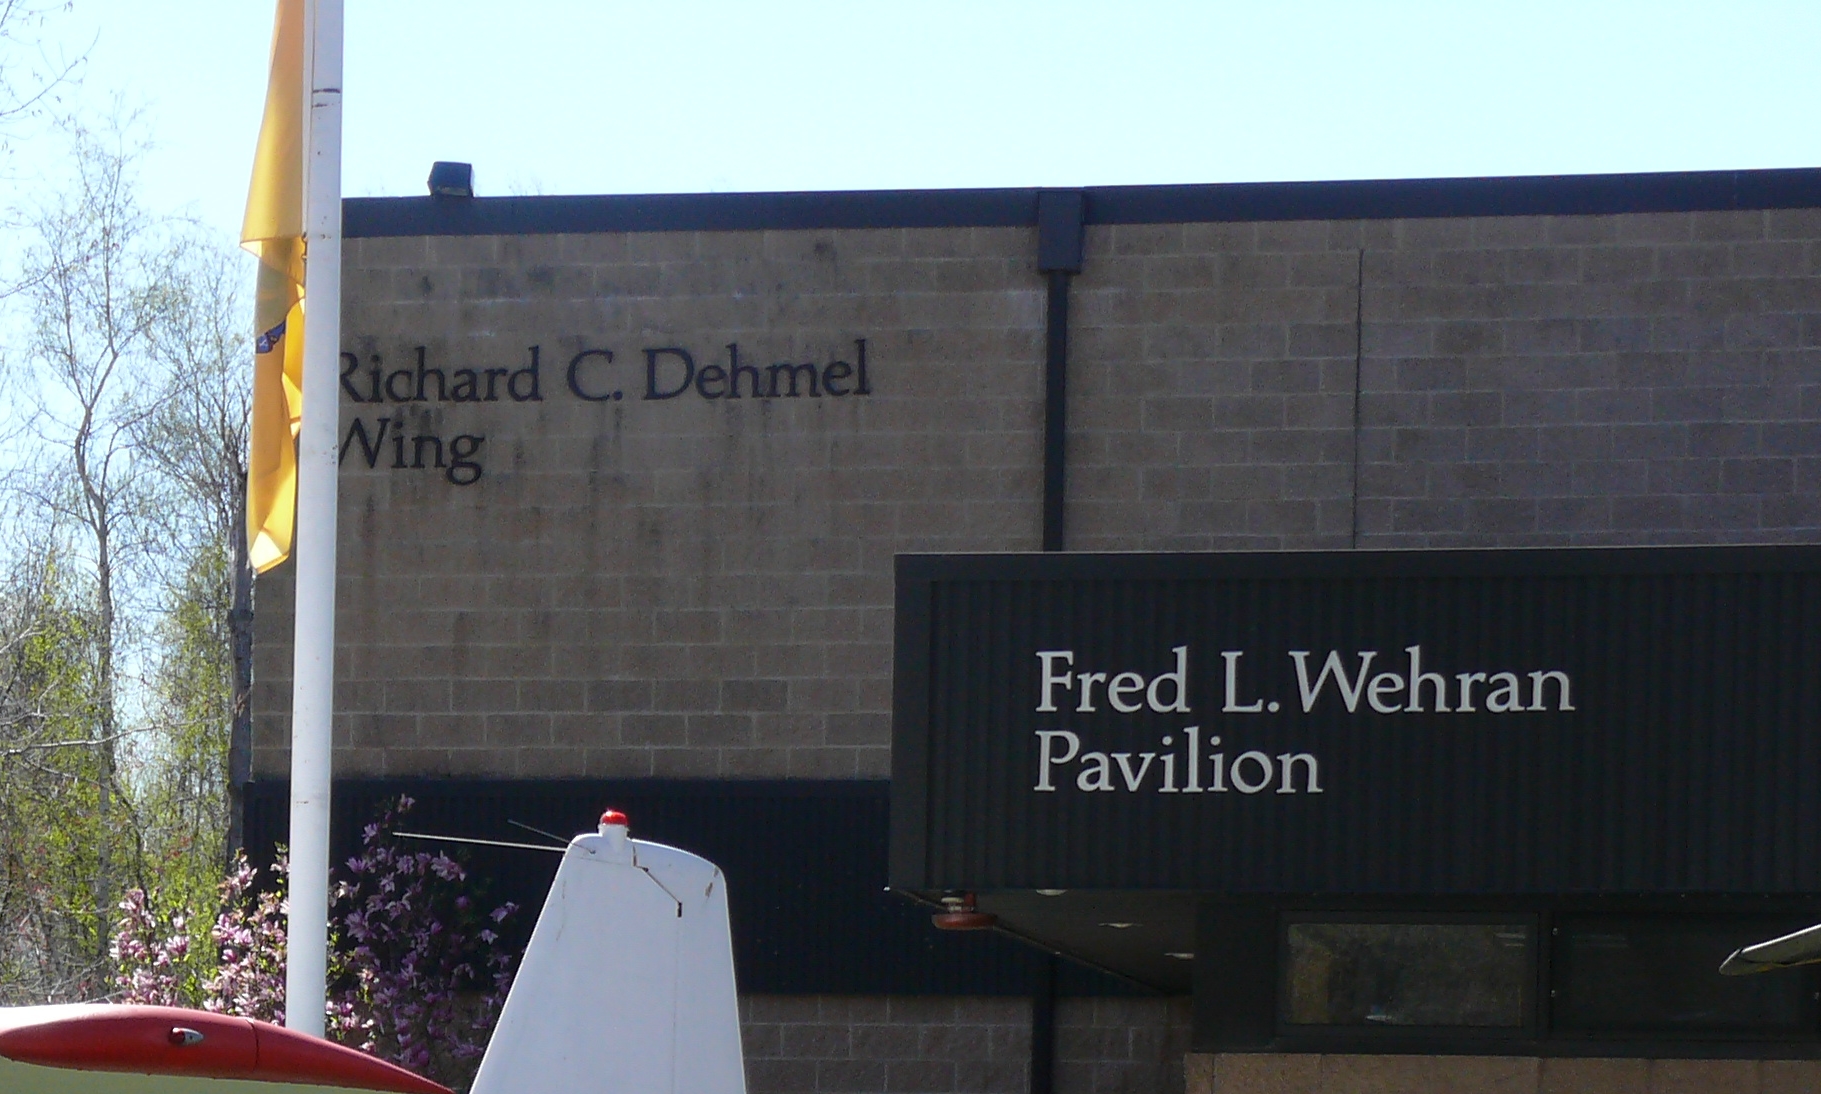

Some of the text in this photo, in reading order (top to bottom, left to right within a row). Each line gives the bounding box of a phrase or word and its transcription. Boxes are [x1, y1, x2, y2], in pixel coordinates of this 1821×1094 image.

[340, 339, 871, 402] Richard C. Dehmel
[338, 417, 485, 486] Wing
[1035, 646, 1190, 713] Fred
[1290, 646, 1575, 713] Wehran
[1034, 726, 1323, 793] Pavilion
